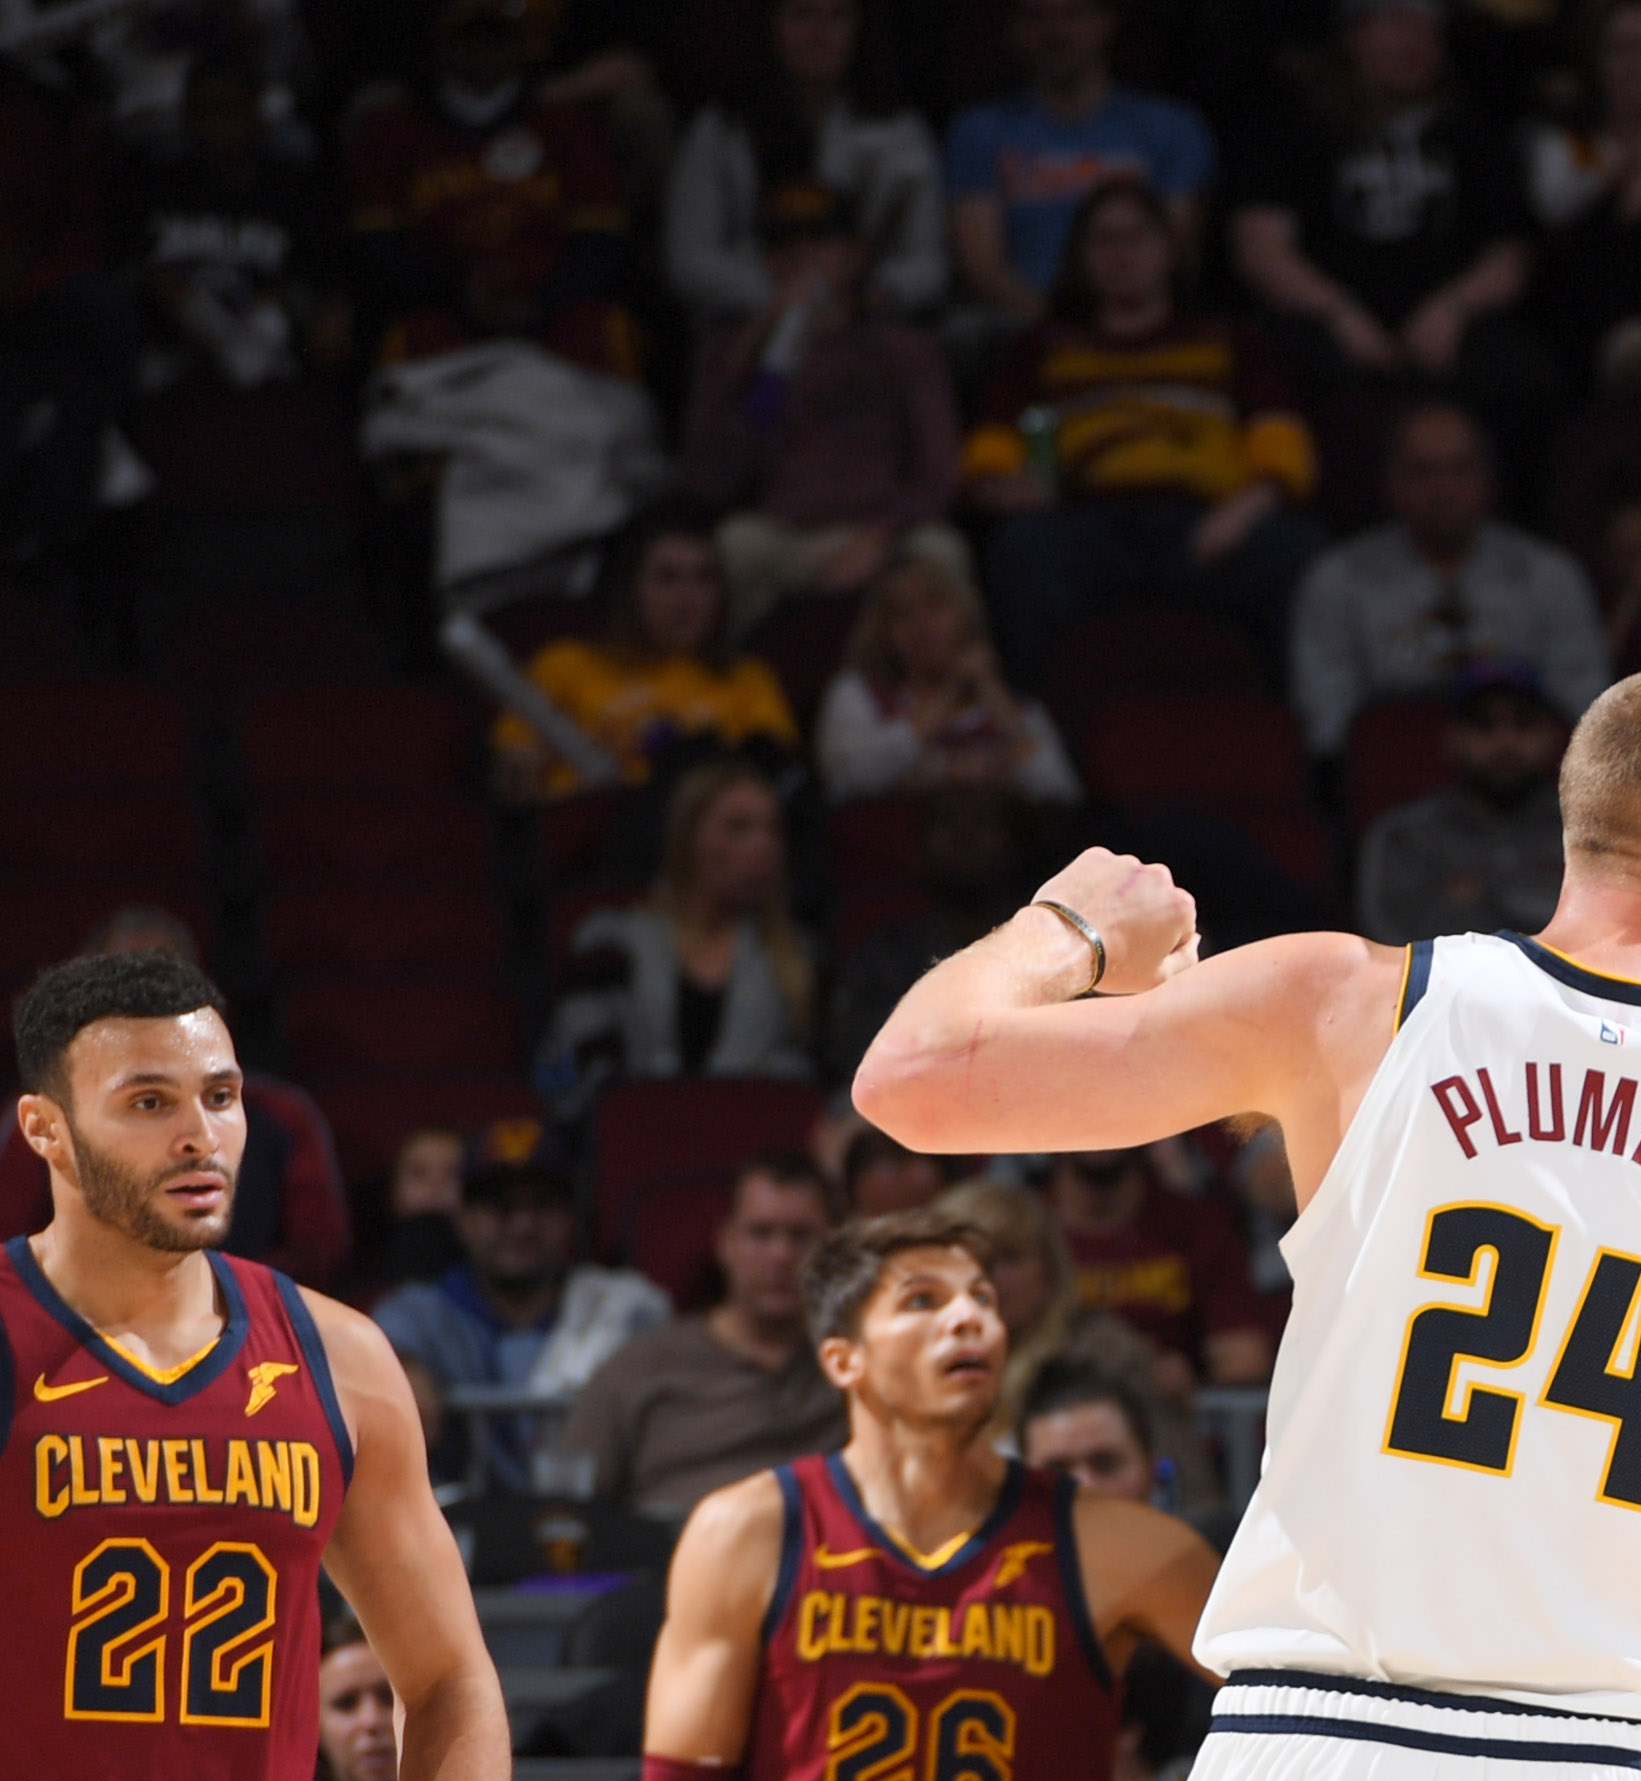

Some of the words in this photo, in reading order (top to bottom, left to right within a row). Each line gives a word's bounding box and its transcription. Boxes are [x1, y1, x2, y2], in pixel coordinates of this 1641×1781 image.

[34, 1433, 321, 1529] CLEVELAND
[64, 1537, 277, 1729] 22
[797, 1589, 1056, 1676] CLEVELAND
